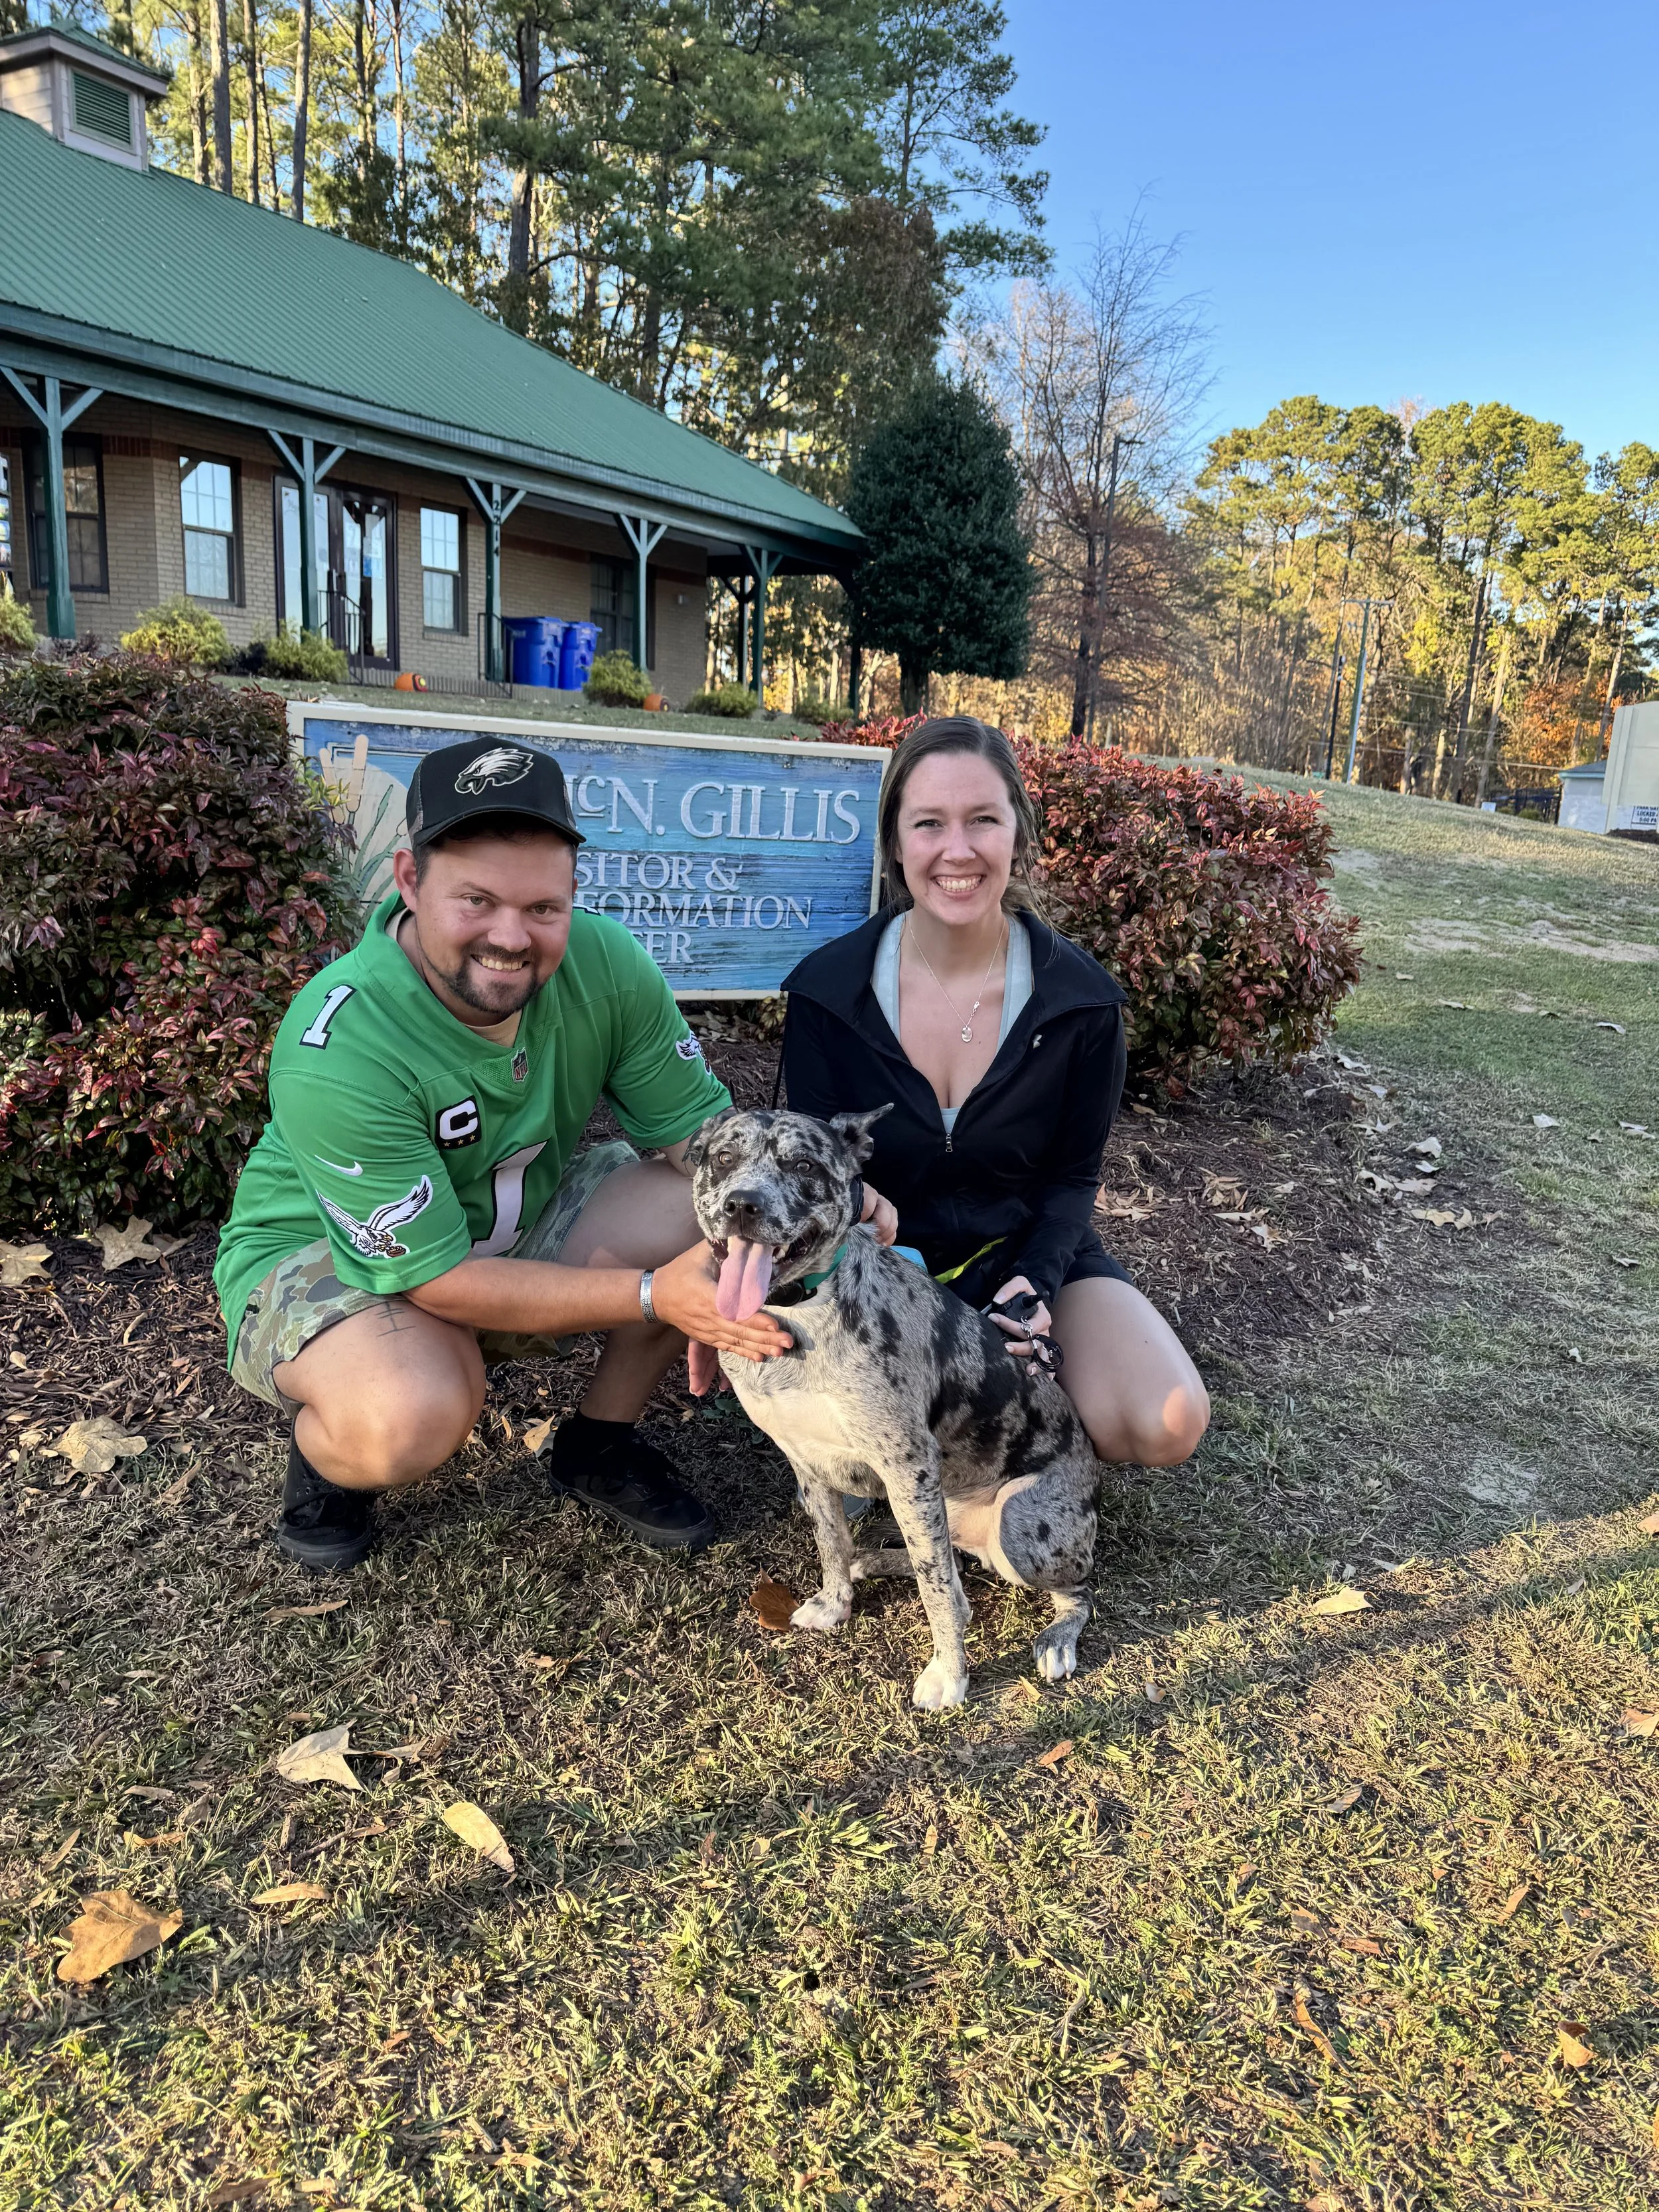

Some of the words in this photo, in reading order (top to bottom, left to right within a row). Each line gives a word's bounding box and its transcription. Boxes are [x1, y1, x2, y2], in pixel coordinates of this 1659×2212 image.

[680, 781, 861, 845] GILLIS
[705, 857, 743, 892] &
[631, 931, 695, 964] ER
[299, 984, 357, 1050] 1
[439, 1100, 478, 1140] C
[472, 1137, 551, 1256] 1
